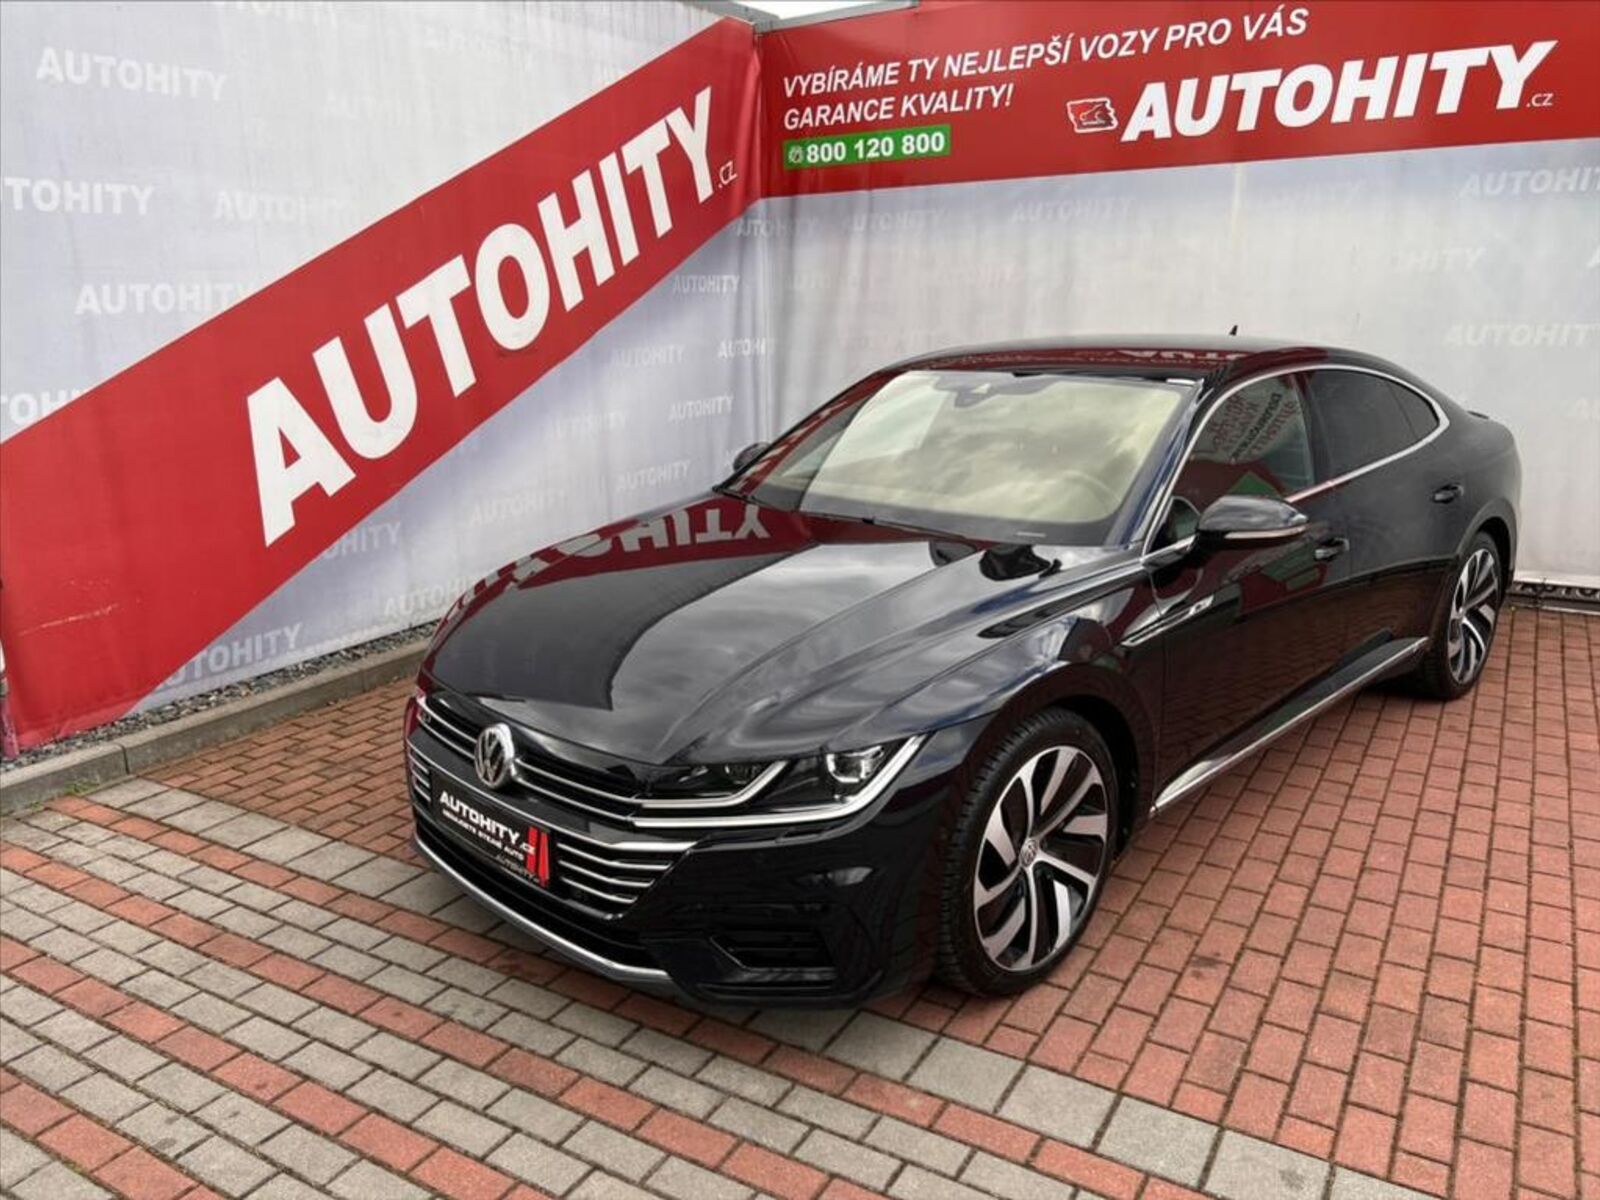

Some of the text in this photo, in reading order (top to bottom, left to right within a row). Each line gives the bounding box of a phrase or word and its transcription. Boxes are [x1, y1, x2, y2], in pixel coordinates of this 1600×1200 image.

[783, 5, 1309, 98] VYBÍRÁME TY NEJLEPŠÍ VOZY PRO VÁS
[37, 46, 228, 101] AUTOHITY
[783, 83, 1015, 131] GARANCE KVALITY!
[806, 131, 945, 164] 800 120 800
[2, 177, 155, 216] TOHITY
[673, 274, 740, 294] AUTOHITY
[668, 395, 734, 422] AUTOHITY
[615, 460, 692, 492] AUTOHITY
